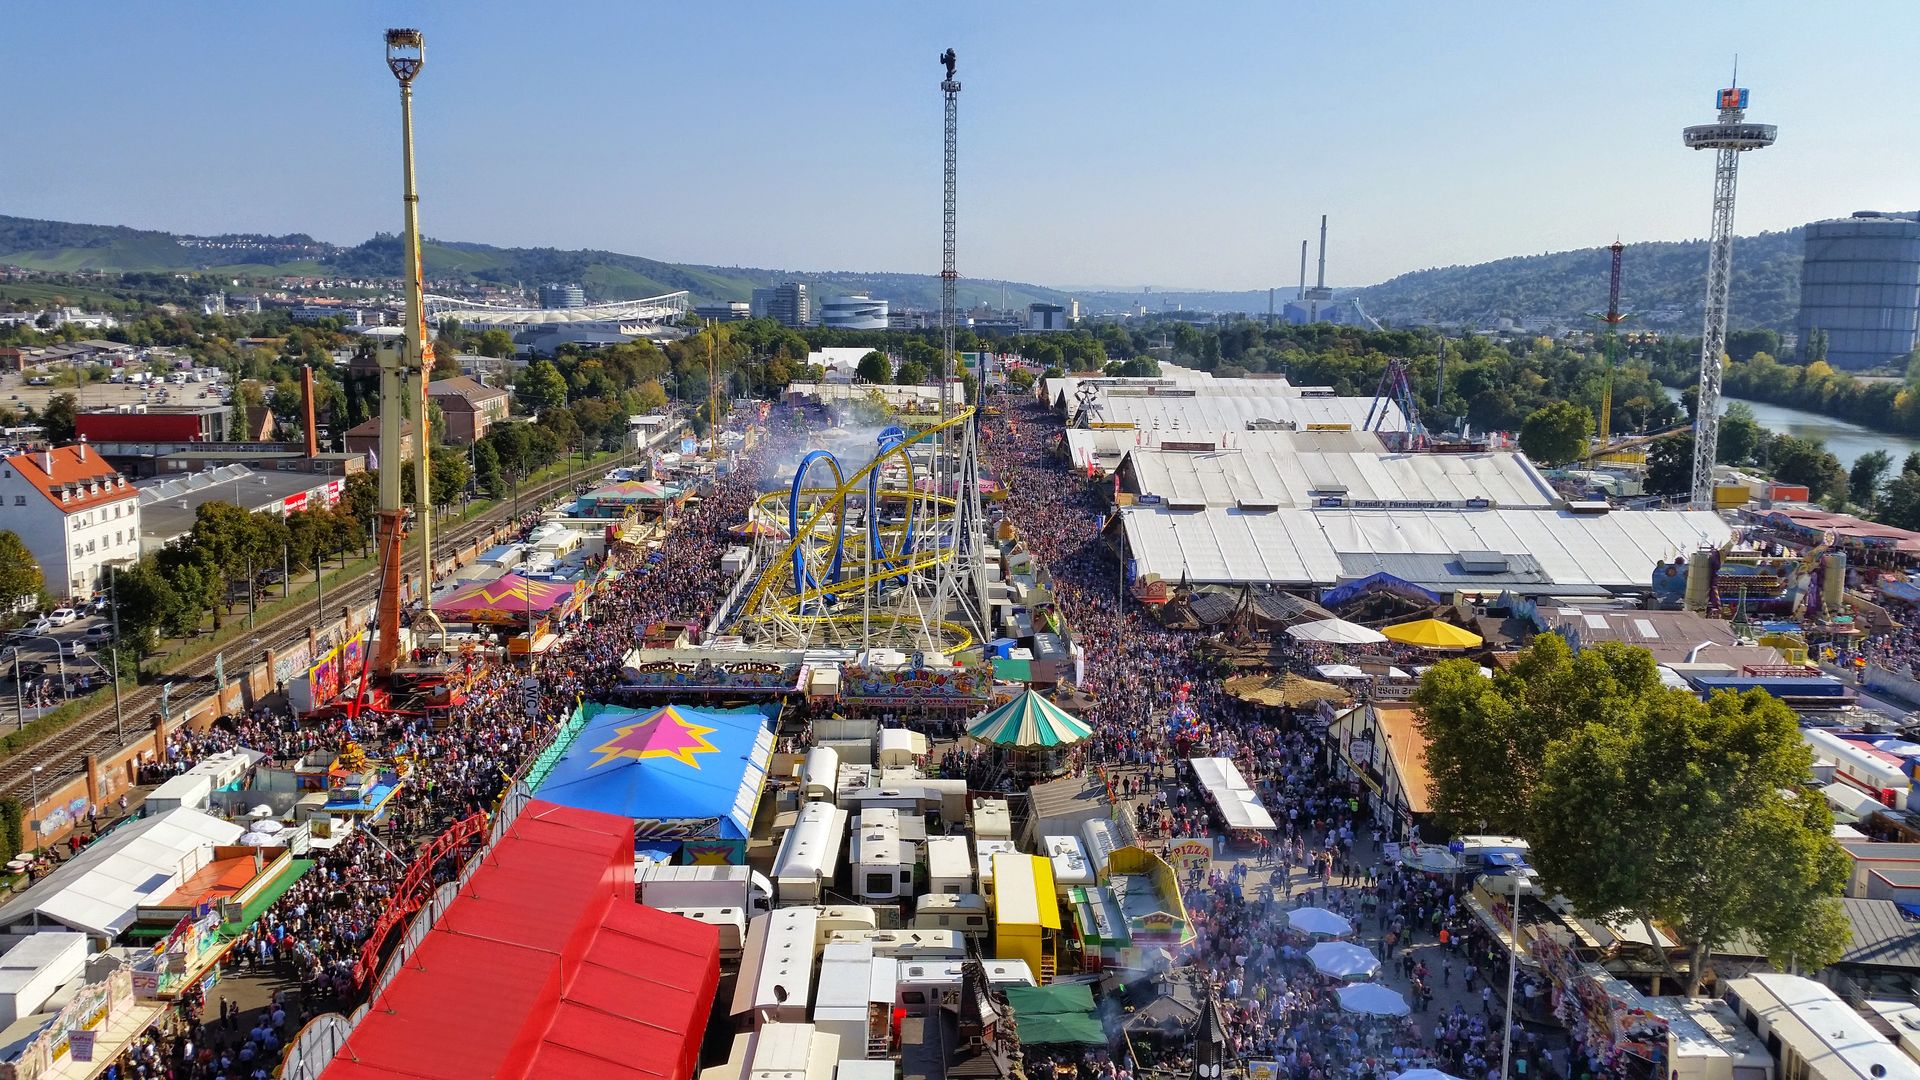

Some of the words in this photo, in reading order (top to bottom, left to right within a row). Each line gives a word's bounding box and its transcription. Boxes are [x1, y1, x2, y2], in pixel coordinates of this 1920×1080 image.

[1389, 500, 1435, 509] Fürstenberg
[1436, 500, 1452, 509] Zelt
[639, 662, 695, 674] ORIENT
[725, 662, 783, 675] ZAUBER
[1377, 686, 1400, 695] Wein
[525, 685, 538, 709] WC
[1173, 844, 1210, 857] PIZZA
[1144, 914, 1173, 924] PIZZA
